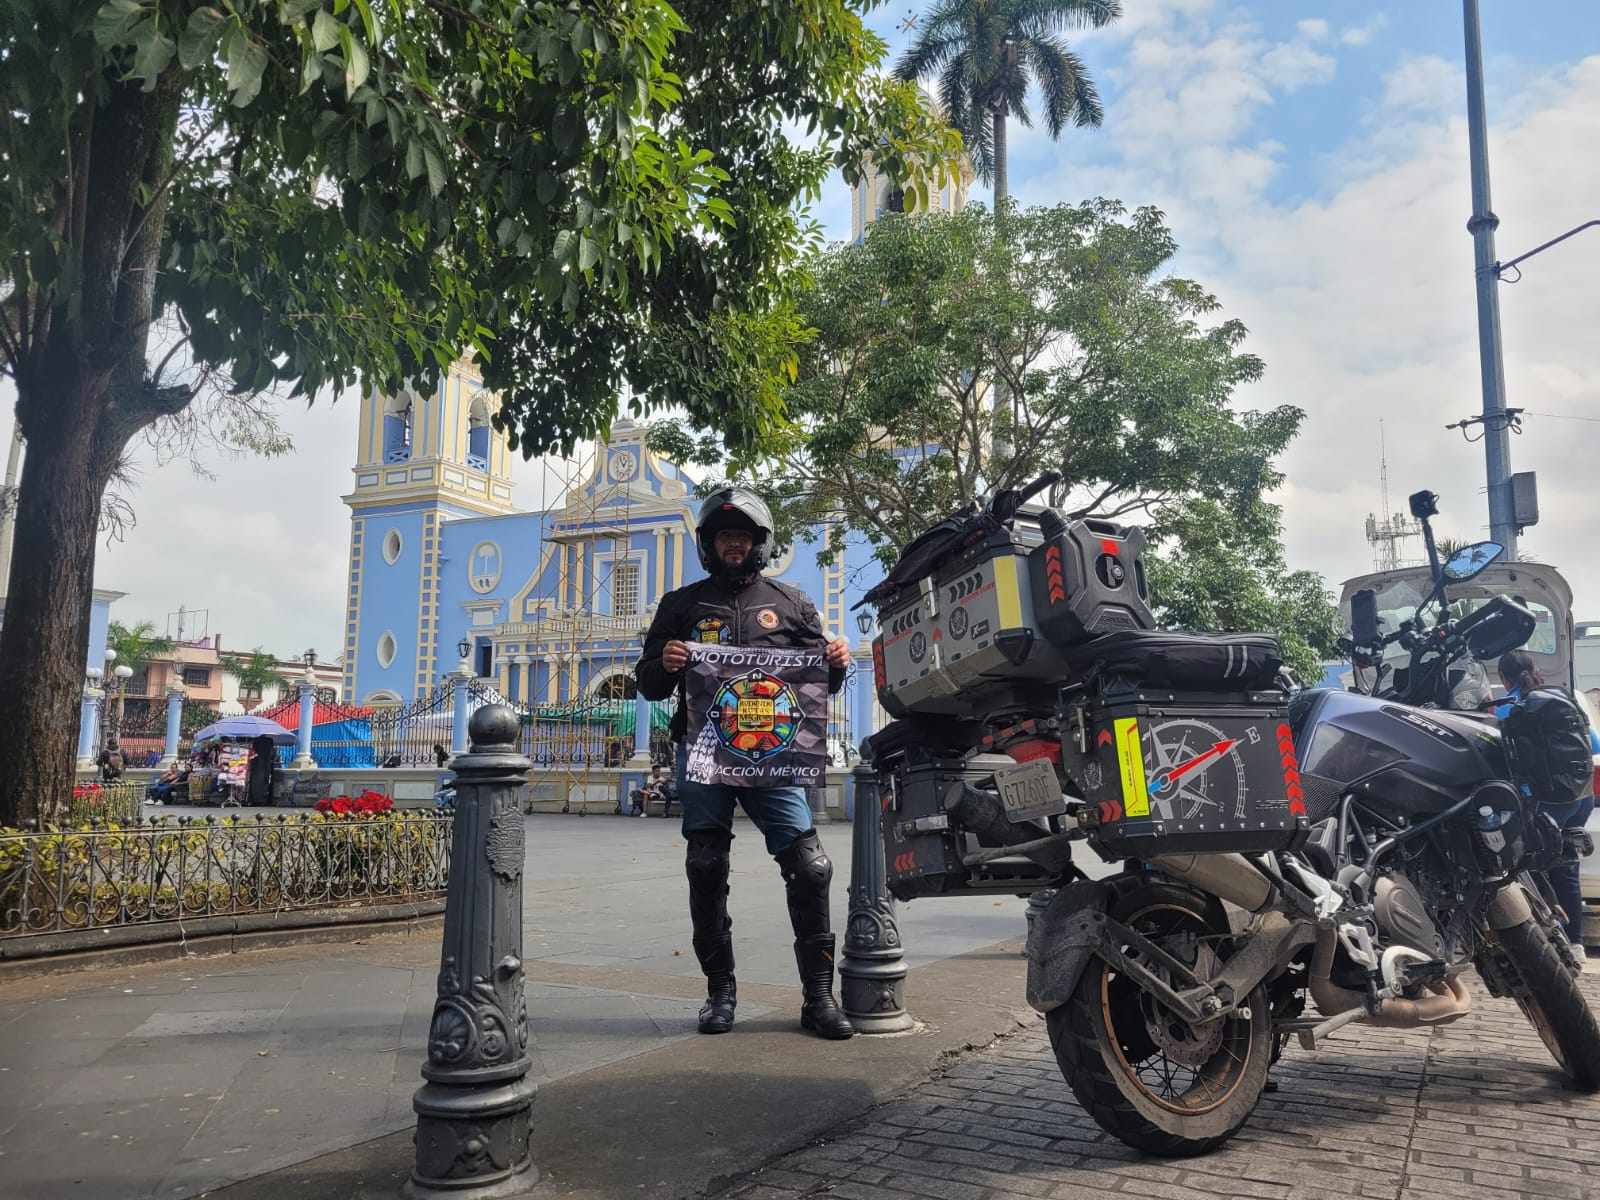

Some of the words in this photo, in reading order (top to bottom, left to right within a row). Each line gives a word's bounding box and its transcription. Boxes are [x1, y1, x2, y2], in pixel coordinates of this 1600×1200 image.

[690, 651, 823, 667] MOTOTURISTA
[1244, 724, 1261, 744] E
[1400, 714, 1454, 737] SRT
[769, 763, 820, 777] MÉXICO
